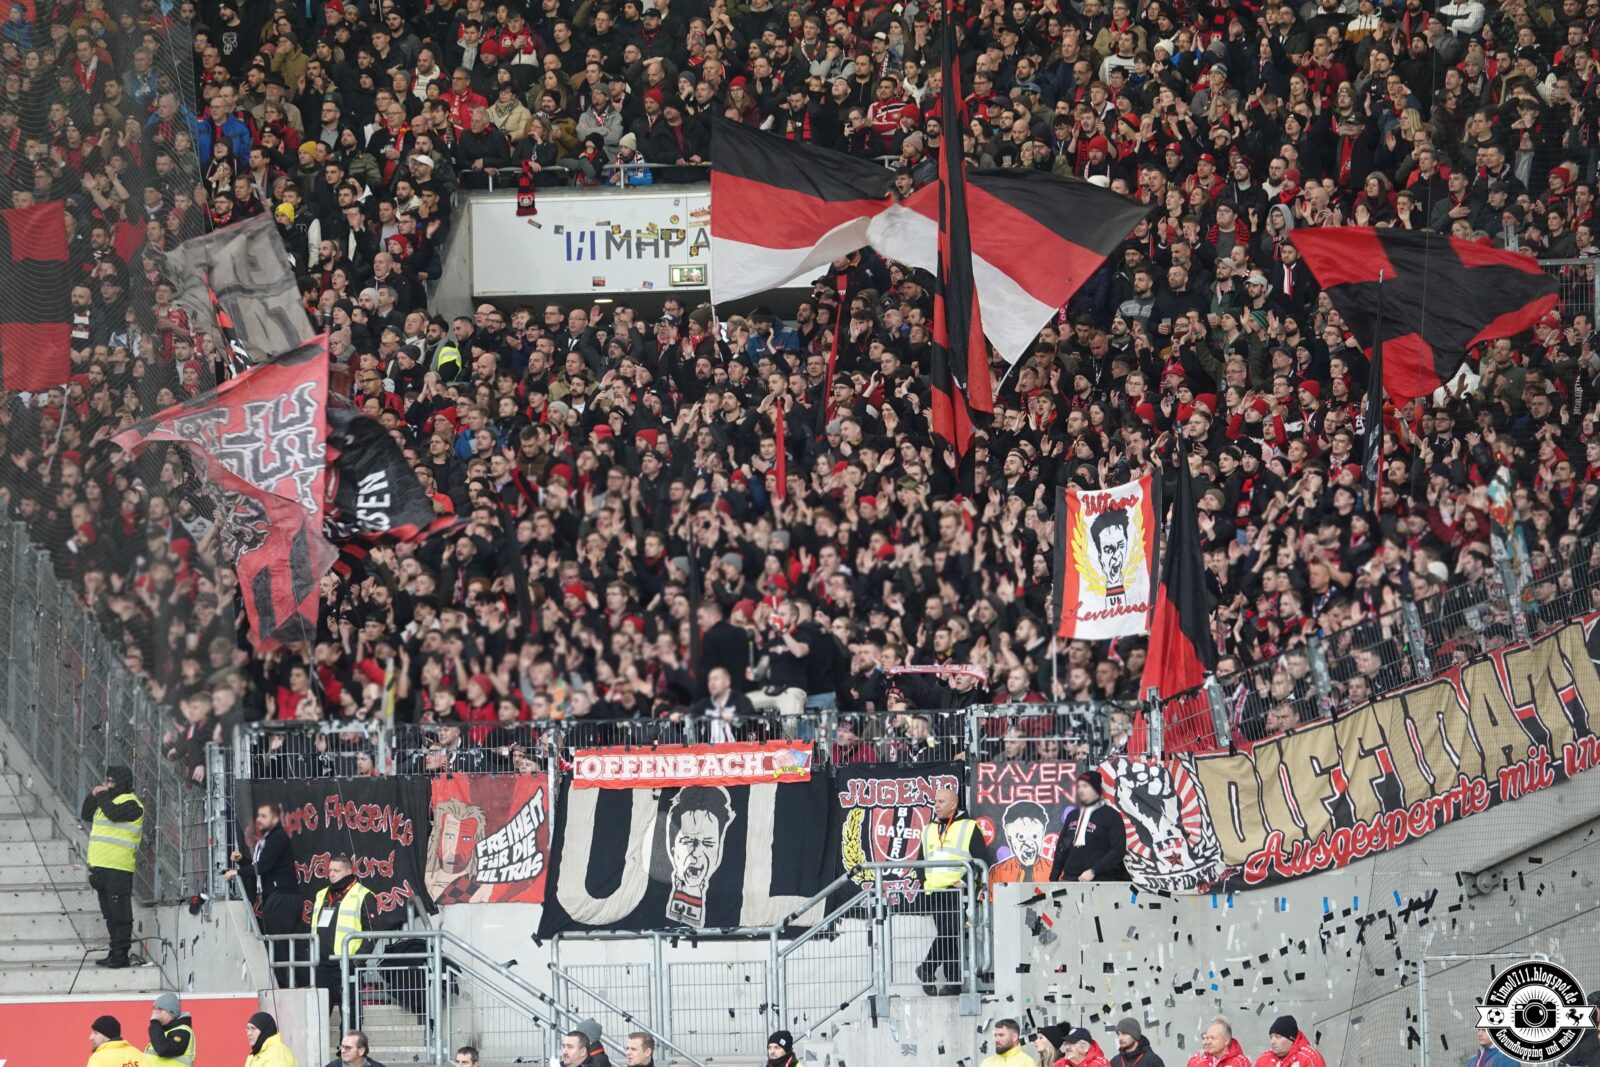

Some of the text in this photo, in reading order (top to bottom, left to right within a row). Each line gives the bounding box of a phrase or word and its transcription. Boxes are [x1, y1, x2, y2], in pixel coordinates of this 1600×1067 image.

[579, 752, 766, 780] OFFENBACH
[977, 762, 1077, 783] RAVER
[977, 783, 1077, 804] KUSEN
[476, 786, 545, 858] FREIHEIT
[1244, 773, 1491, 884] Ausgesperrte
[1498, 743, 1555, 801] mit
[478, 831, 536, 870] FÜR DIE
[476, 852, 544, 882] ULTRAS
